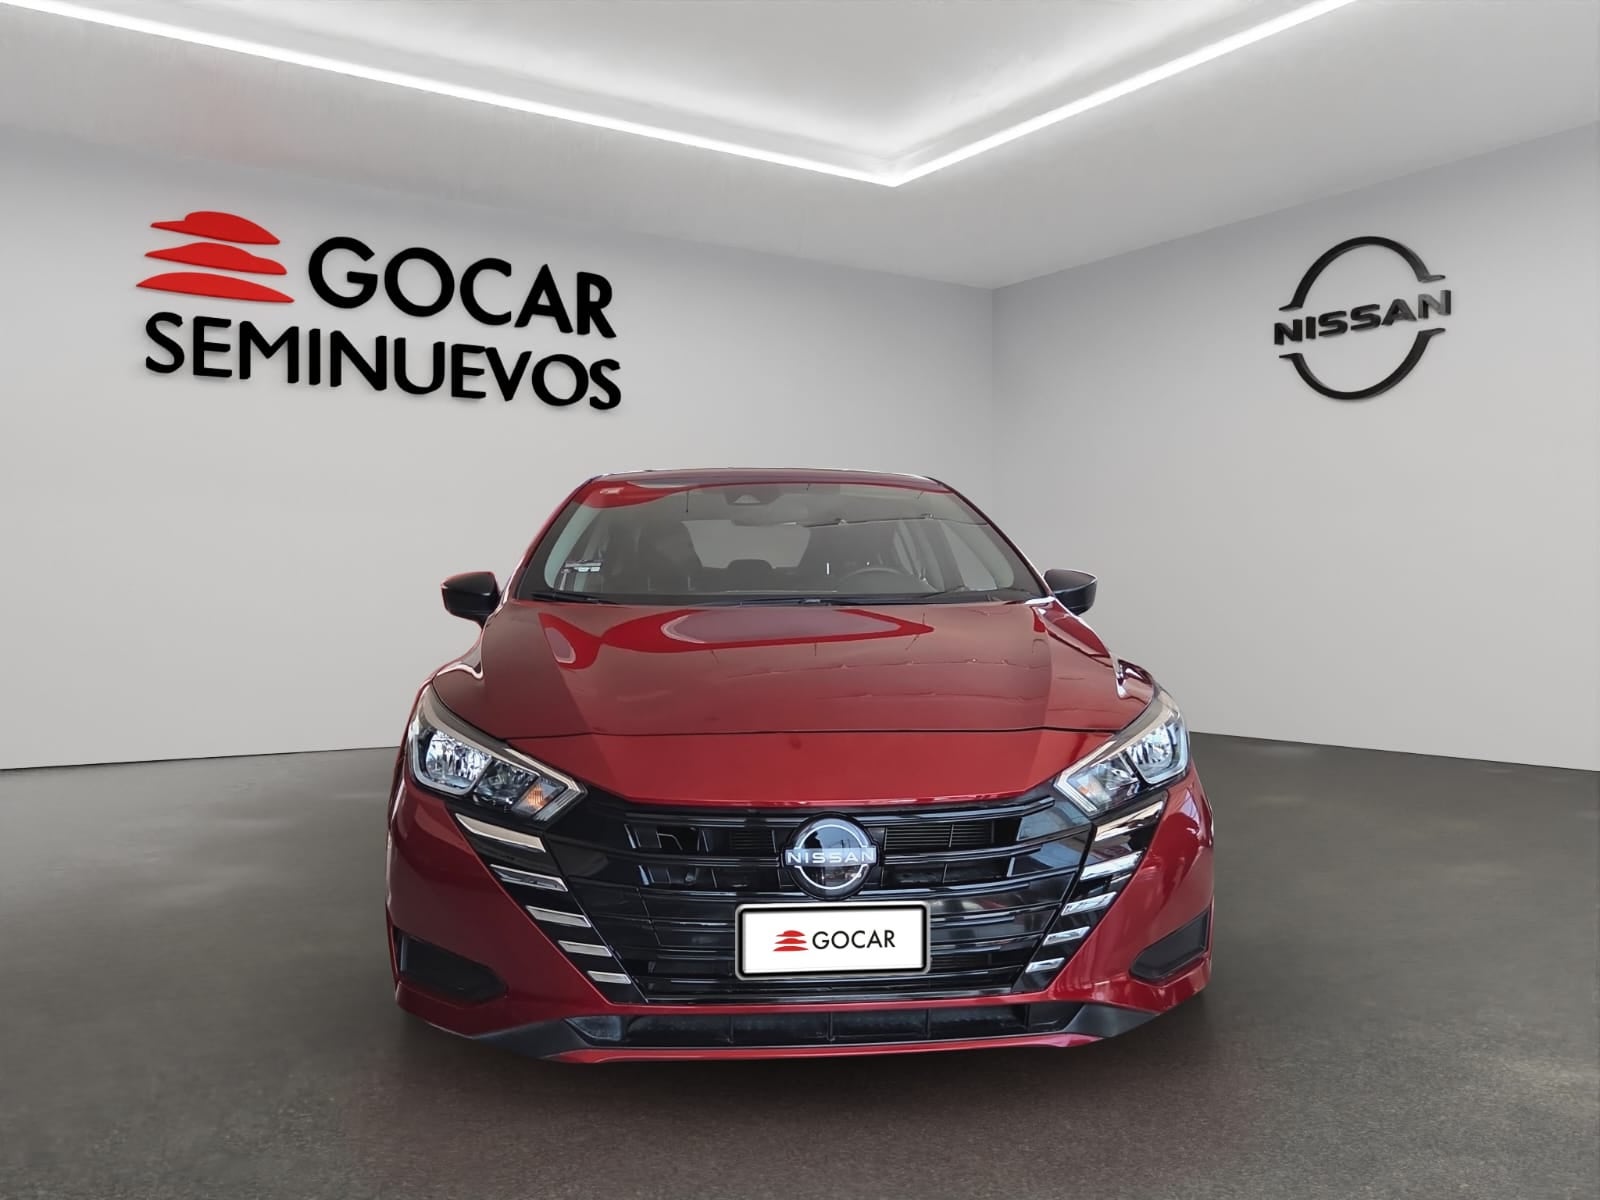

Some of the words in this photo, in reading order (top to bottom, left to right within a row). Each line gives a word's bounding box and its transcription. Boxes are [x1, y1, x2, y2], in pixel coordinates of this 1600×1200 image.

[308, 236, 617, 339] GOCAR
[1274, 289, 1452, 345] NISSAN
[145, 311, 622, 411] SEMINUEVOS
[787, 848, 875, 864] NISSAN
[812, 929, 896, 950] GOCAR
